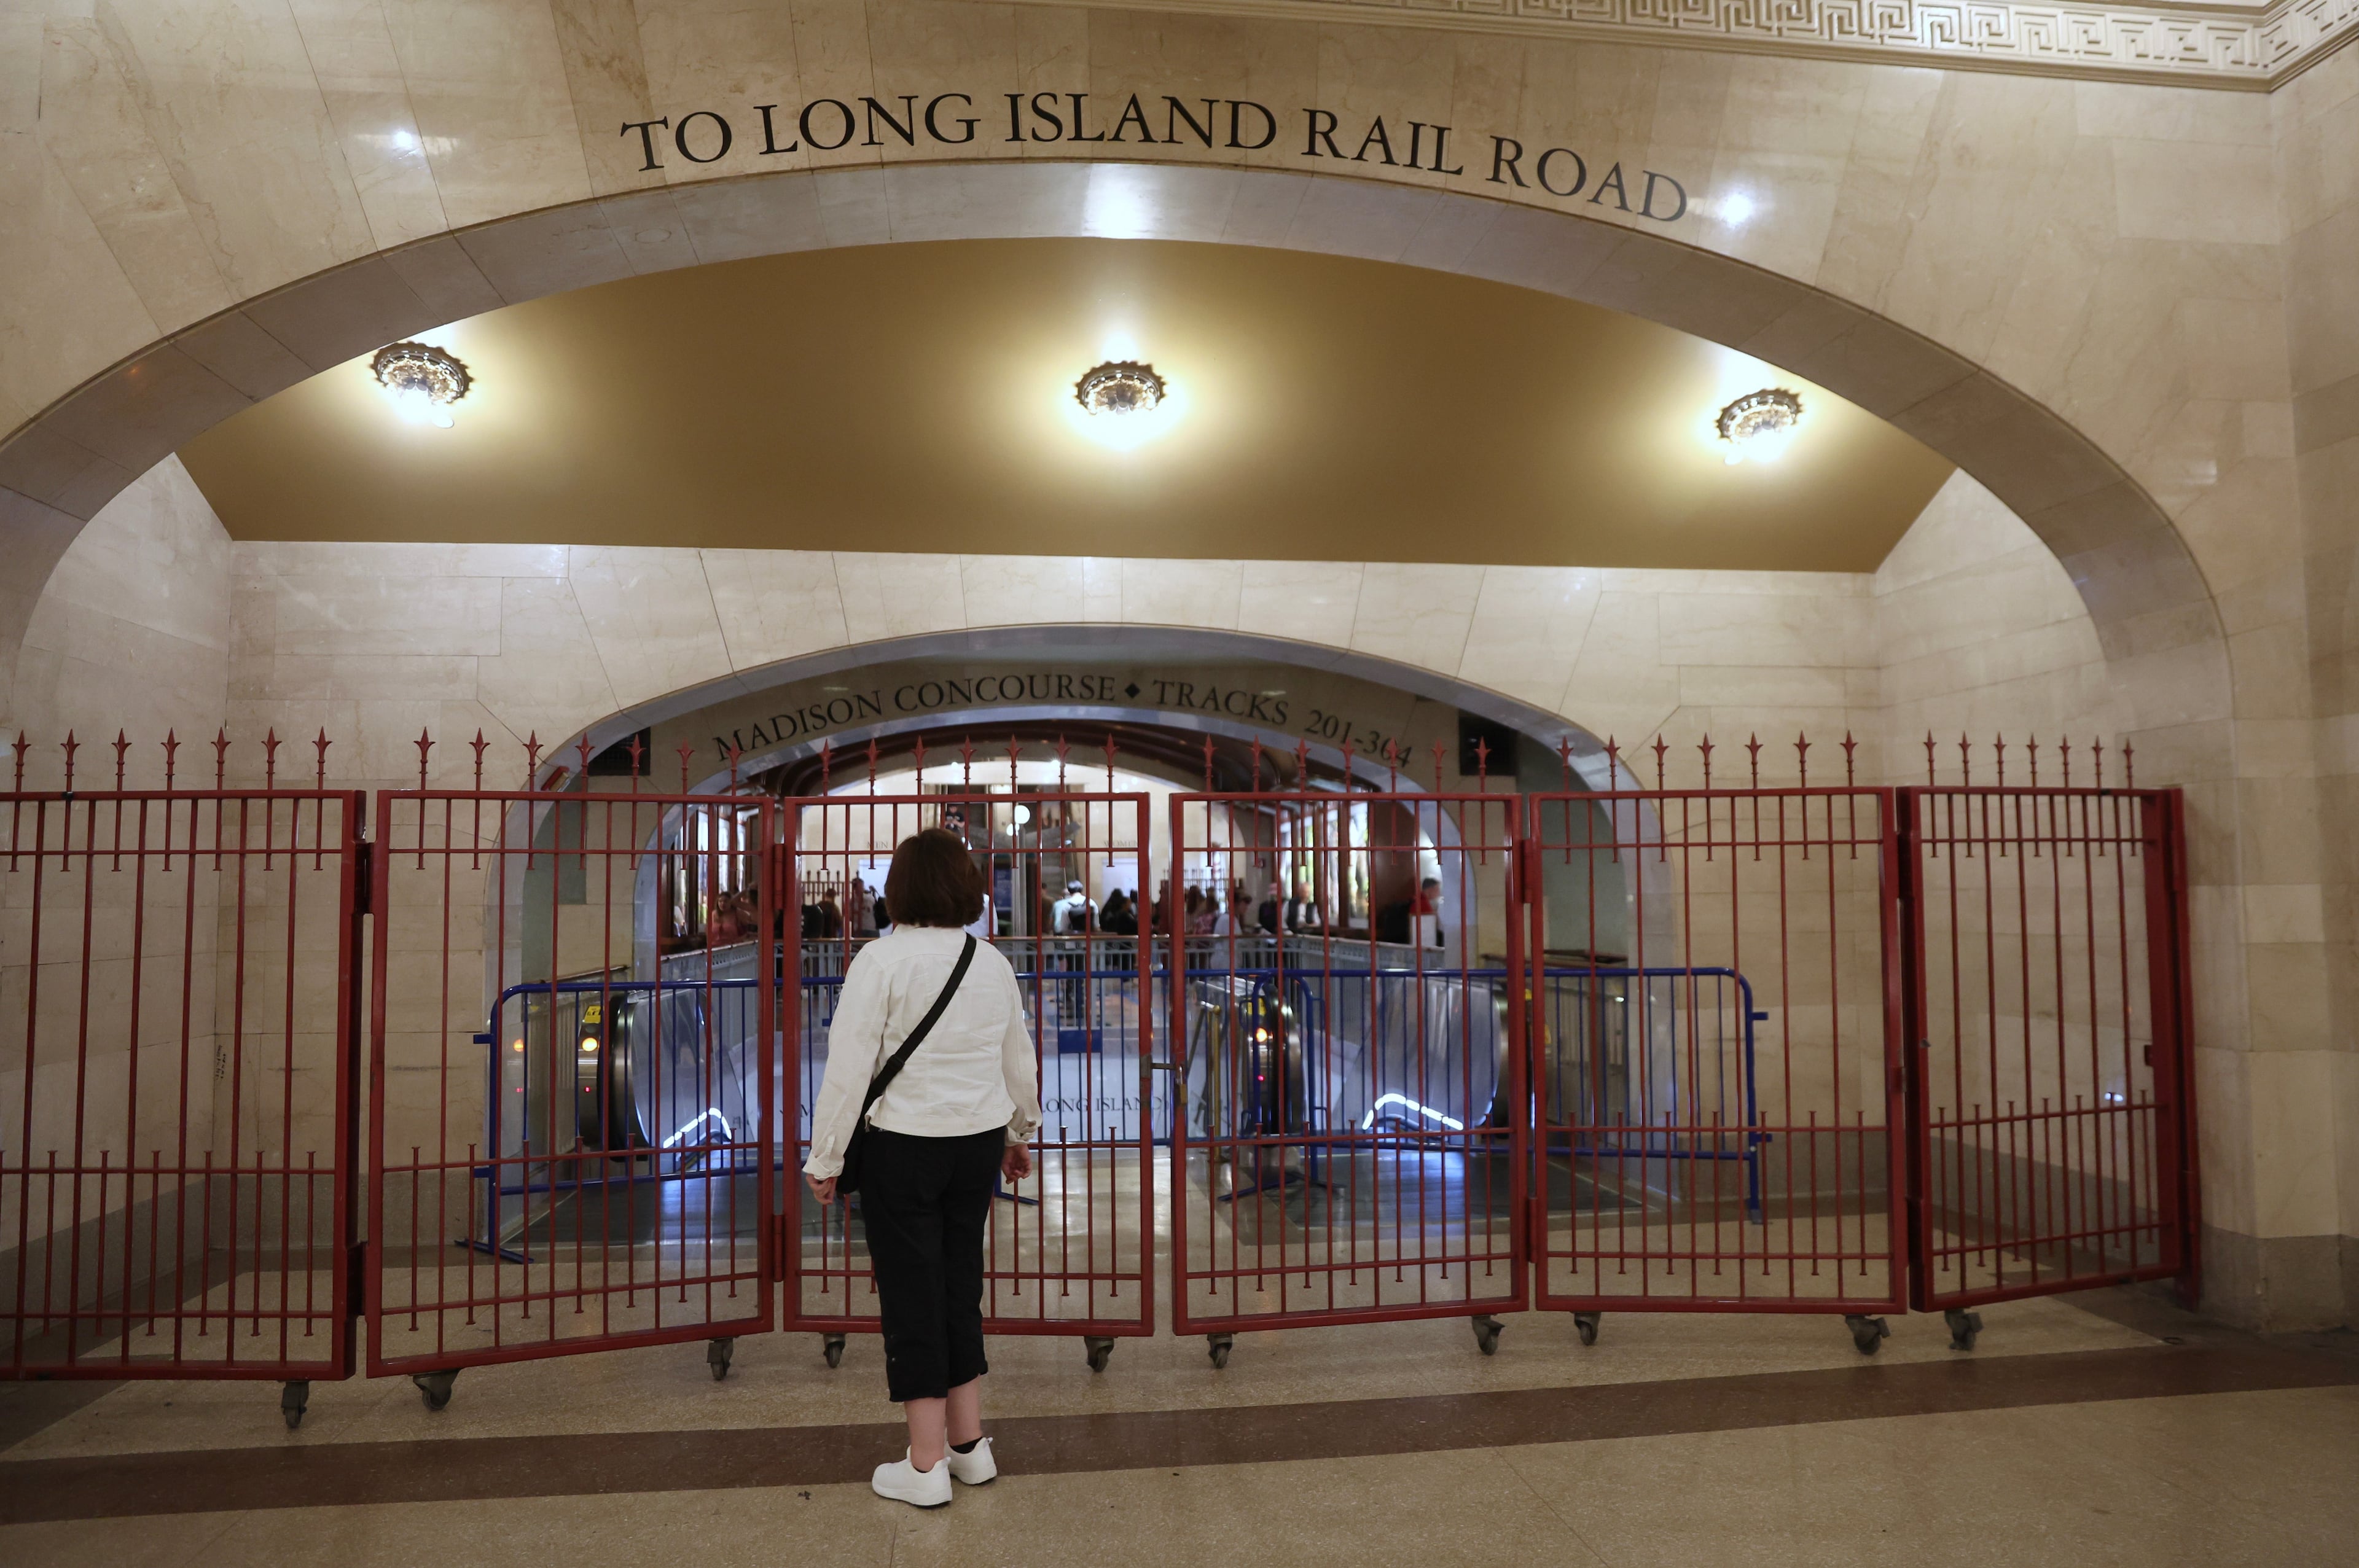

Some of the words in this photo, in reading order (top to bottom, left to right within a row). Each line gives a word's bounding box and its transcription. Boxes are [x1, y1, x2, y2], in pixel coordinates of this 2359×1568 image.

[620, 111, 732, 172] TO
[753, 93, 982, 155] LONG
[1004, 92, 1277, 149] ISLAND
[1301, 107, 1465, 176] RAIL
[1485, 135, 1688, 222] ROAD
[712, 690, 882, 762] MADISON
[894, 674, 1116, 711] CONCOURSE
[1153, 679, 1289, 725] TRACKS
[1042, 1098, 1091, 1112] ONG
